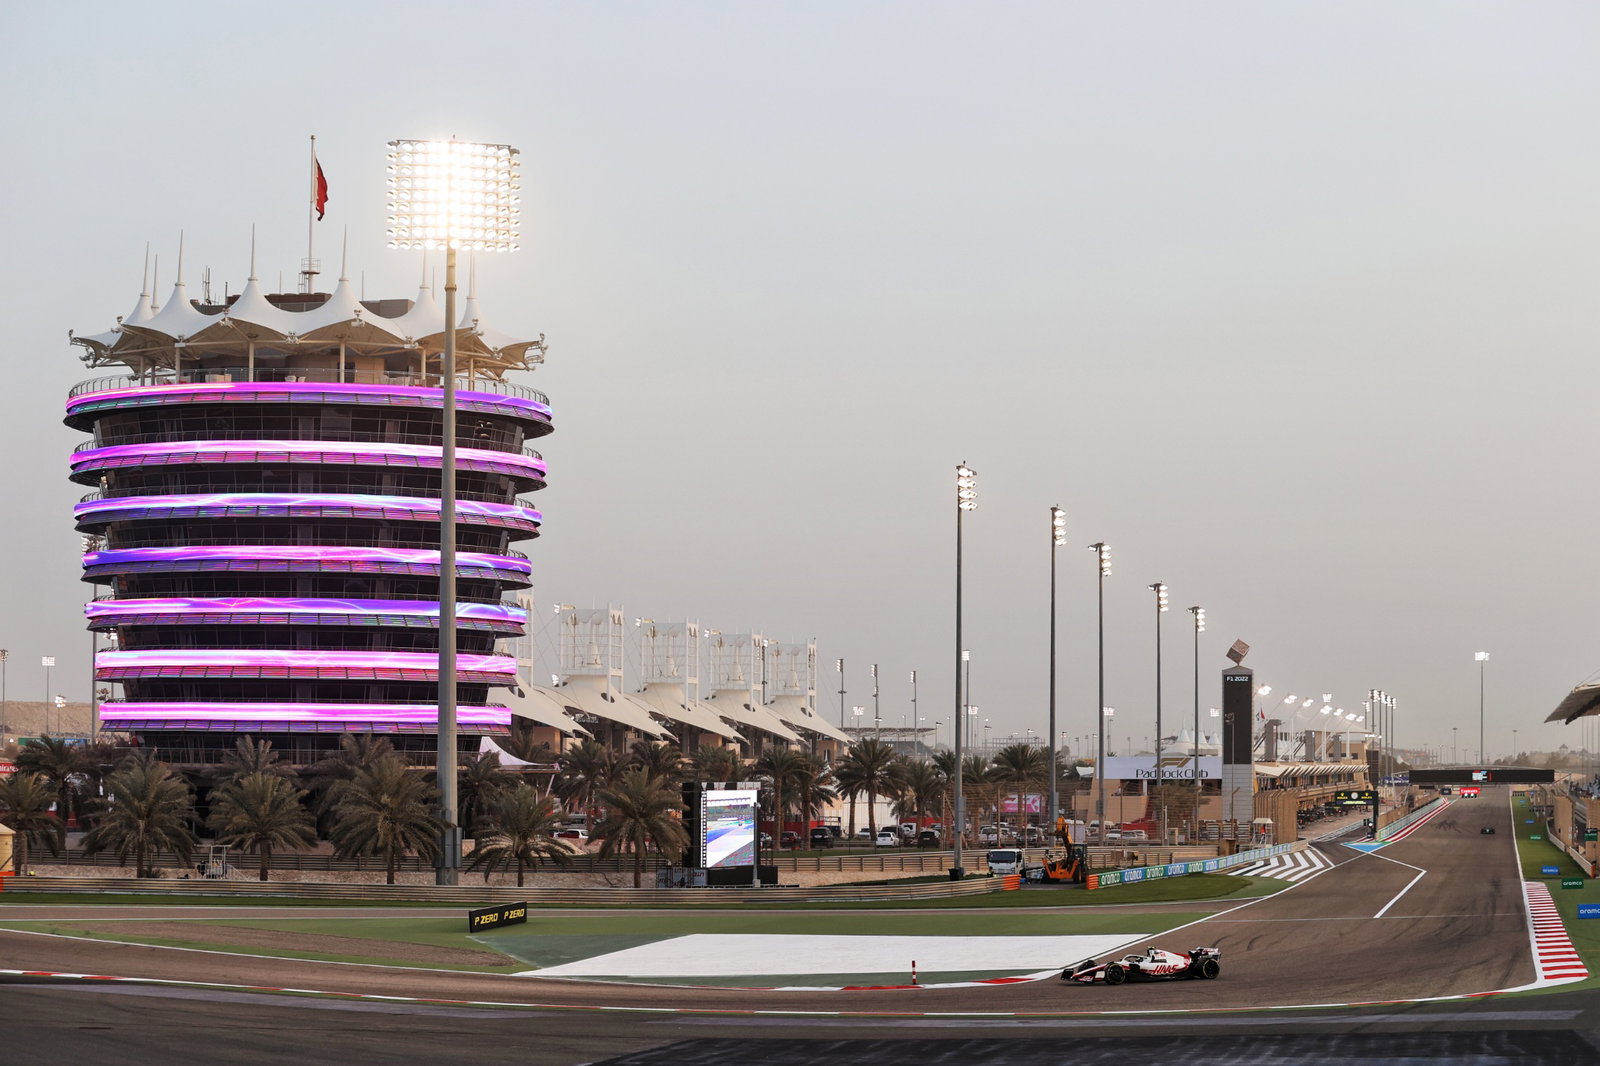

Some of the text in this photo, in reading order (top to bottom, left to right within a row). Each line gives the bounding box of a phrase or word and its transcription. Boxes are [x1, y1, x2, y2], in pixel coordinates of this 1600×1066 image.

[1146, 867, 1164, 879] aramco
[1168, 864, 1185, 875] aramco
[1101, 872, 1121, 886] aramco
[1124, 870, 1142, 882] aramco
[474, 913, 499, 926] P ZERO
[503, 908, 525, 920] P ZERO
